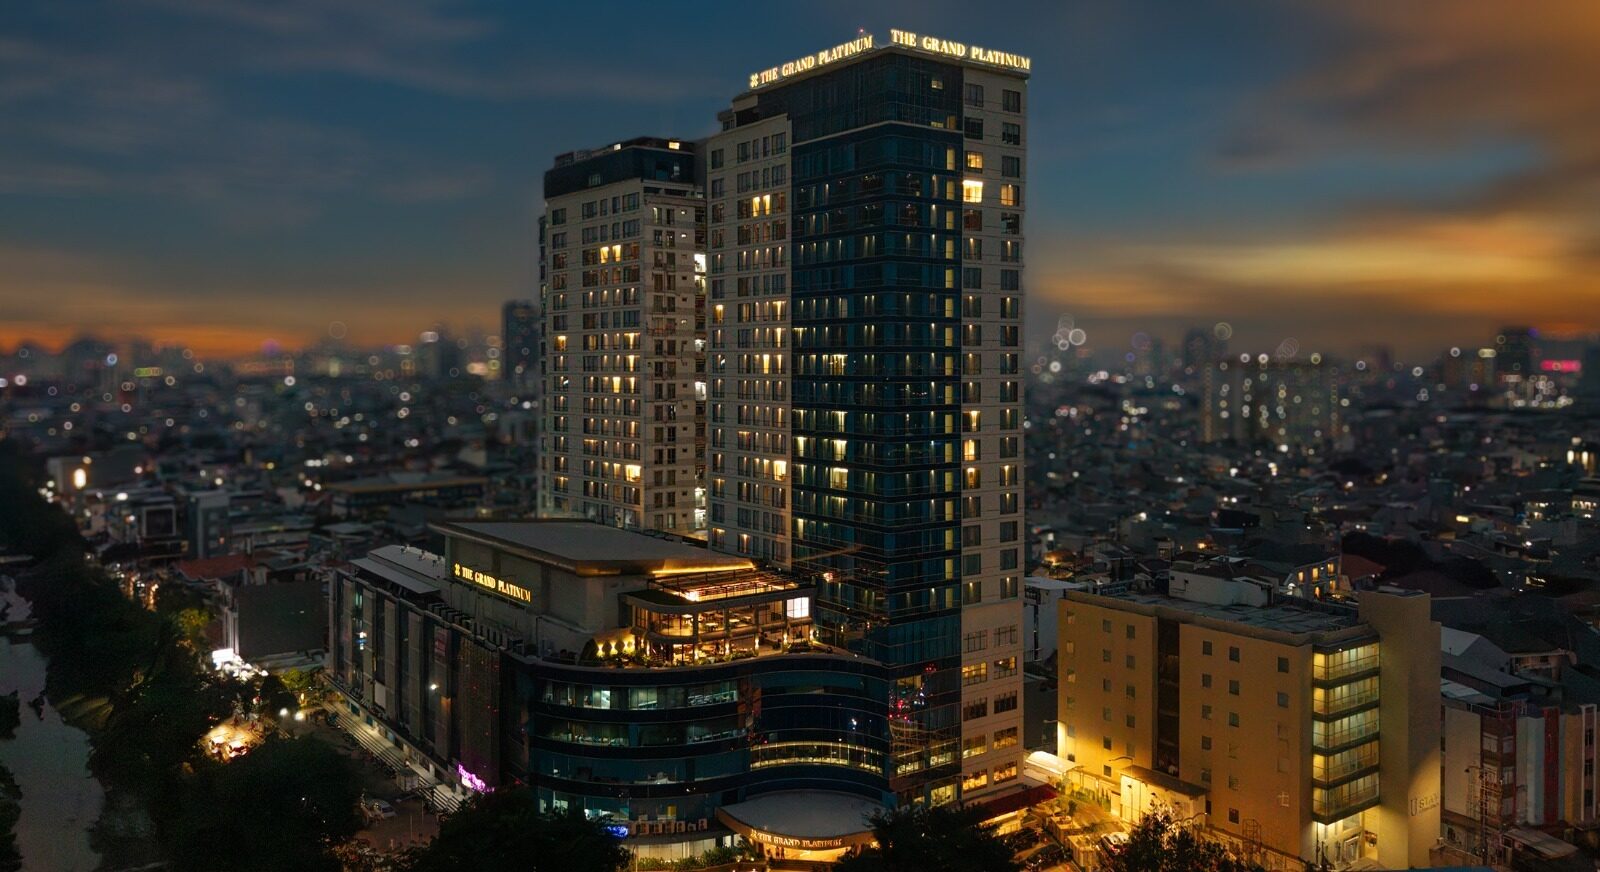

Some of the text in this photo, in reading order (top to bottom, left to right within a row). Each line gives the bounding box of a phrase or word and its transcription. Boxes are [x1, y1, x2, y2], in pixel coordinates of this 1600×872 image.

[760, 35, 873, 84] THE GRAND PLATINUM
[890, 29, 1030, 69] THE GRAND PLATINUM
[462, 567, 531, 602] THE GRAND PLATINUM
[773, 837, 801, 847] GRAND
